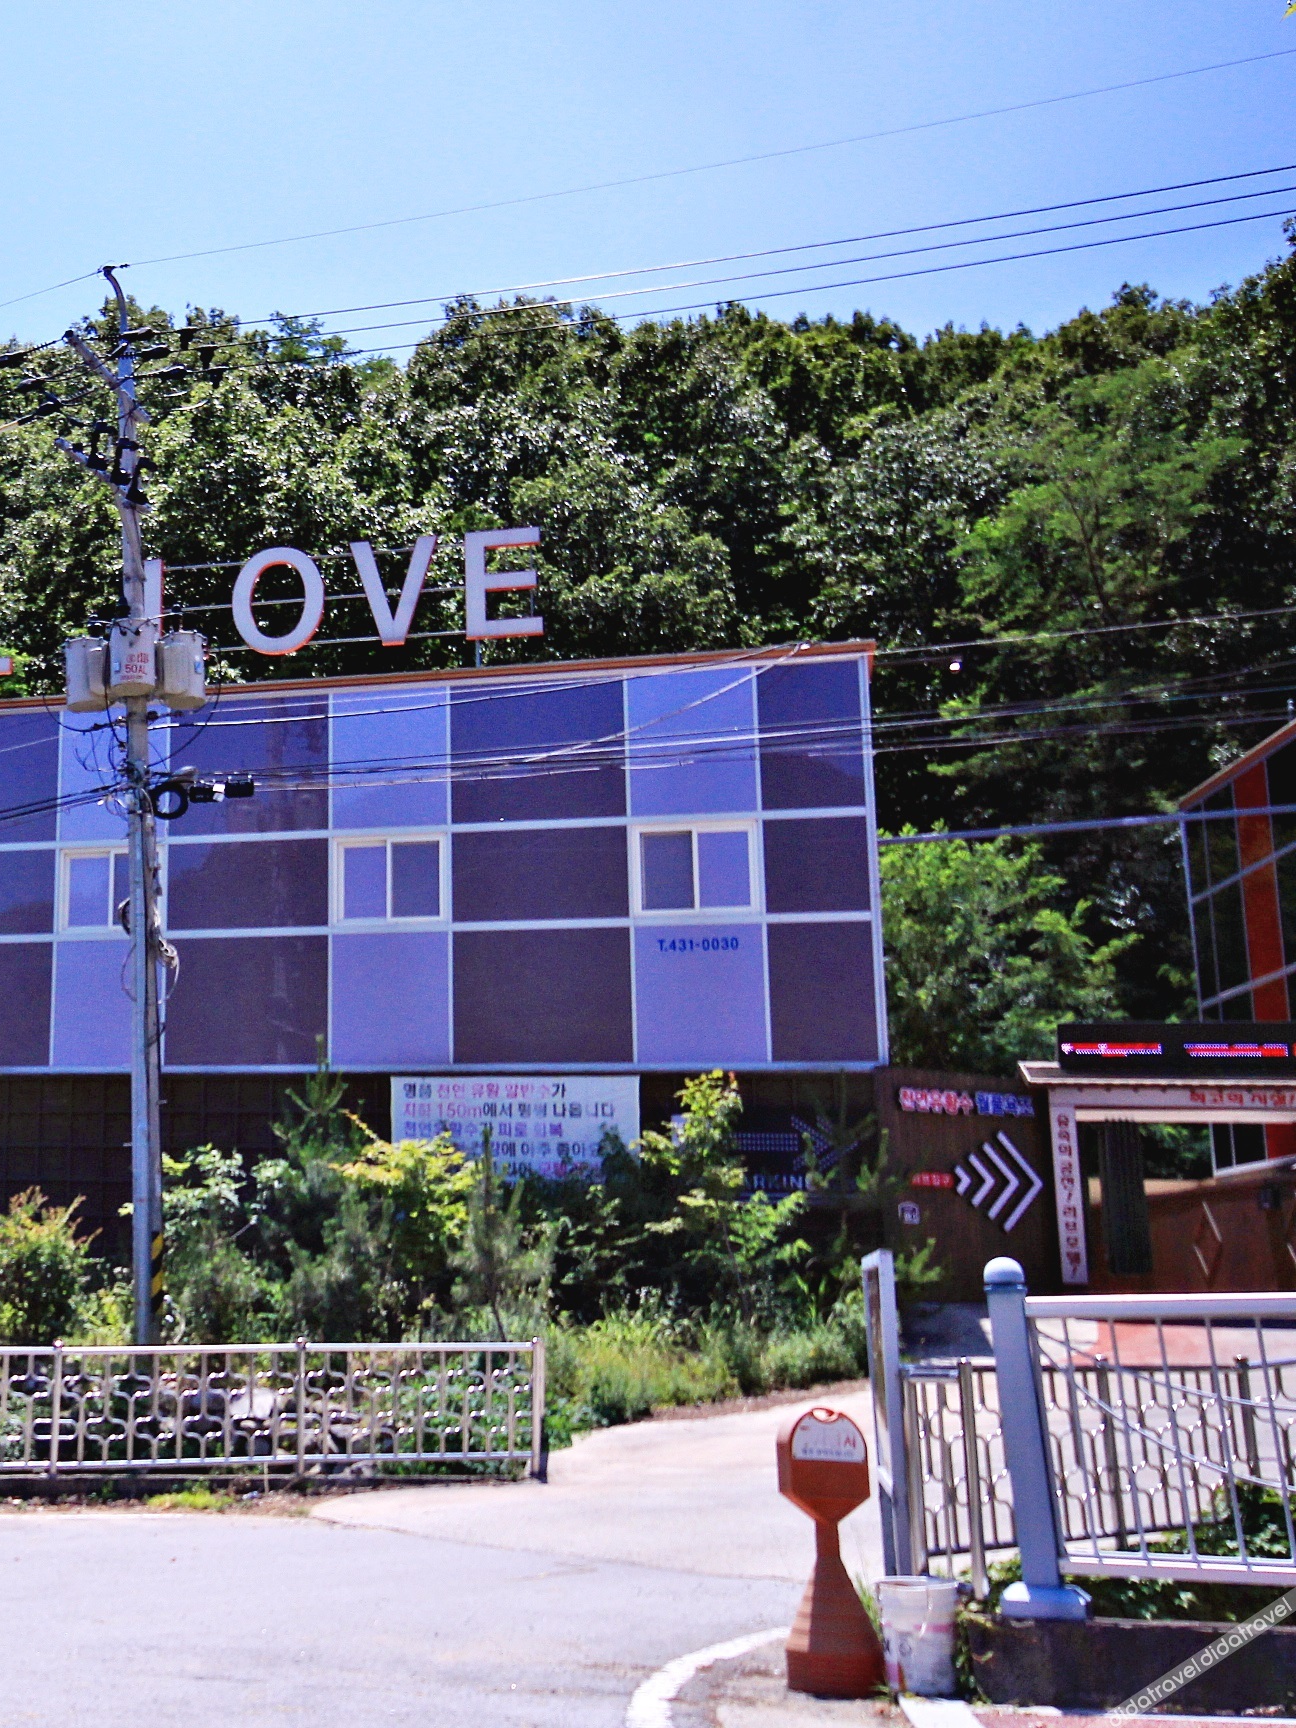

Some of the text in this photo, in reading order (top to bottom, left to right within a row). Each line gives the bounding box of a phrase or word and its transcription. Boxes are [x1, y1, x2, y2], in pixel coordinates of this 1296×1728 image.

[657, 936, 739, 953] T.431-0030
[437, 1083, 465, 1099] 천연
[472, 1083, 500, 1099] 유황
[404, 1102, 431, 1118] 지하
